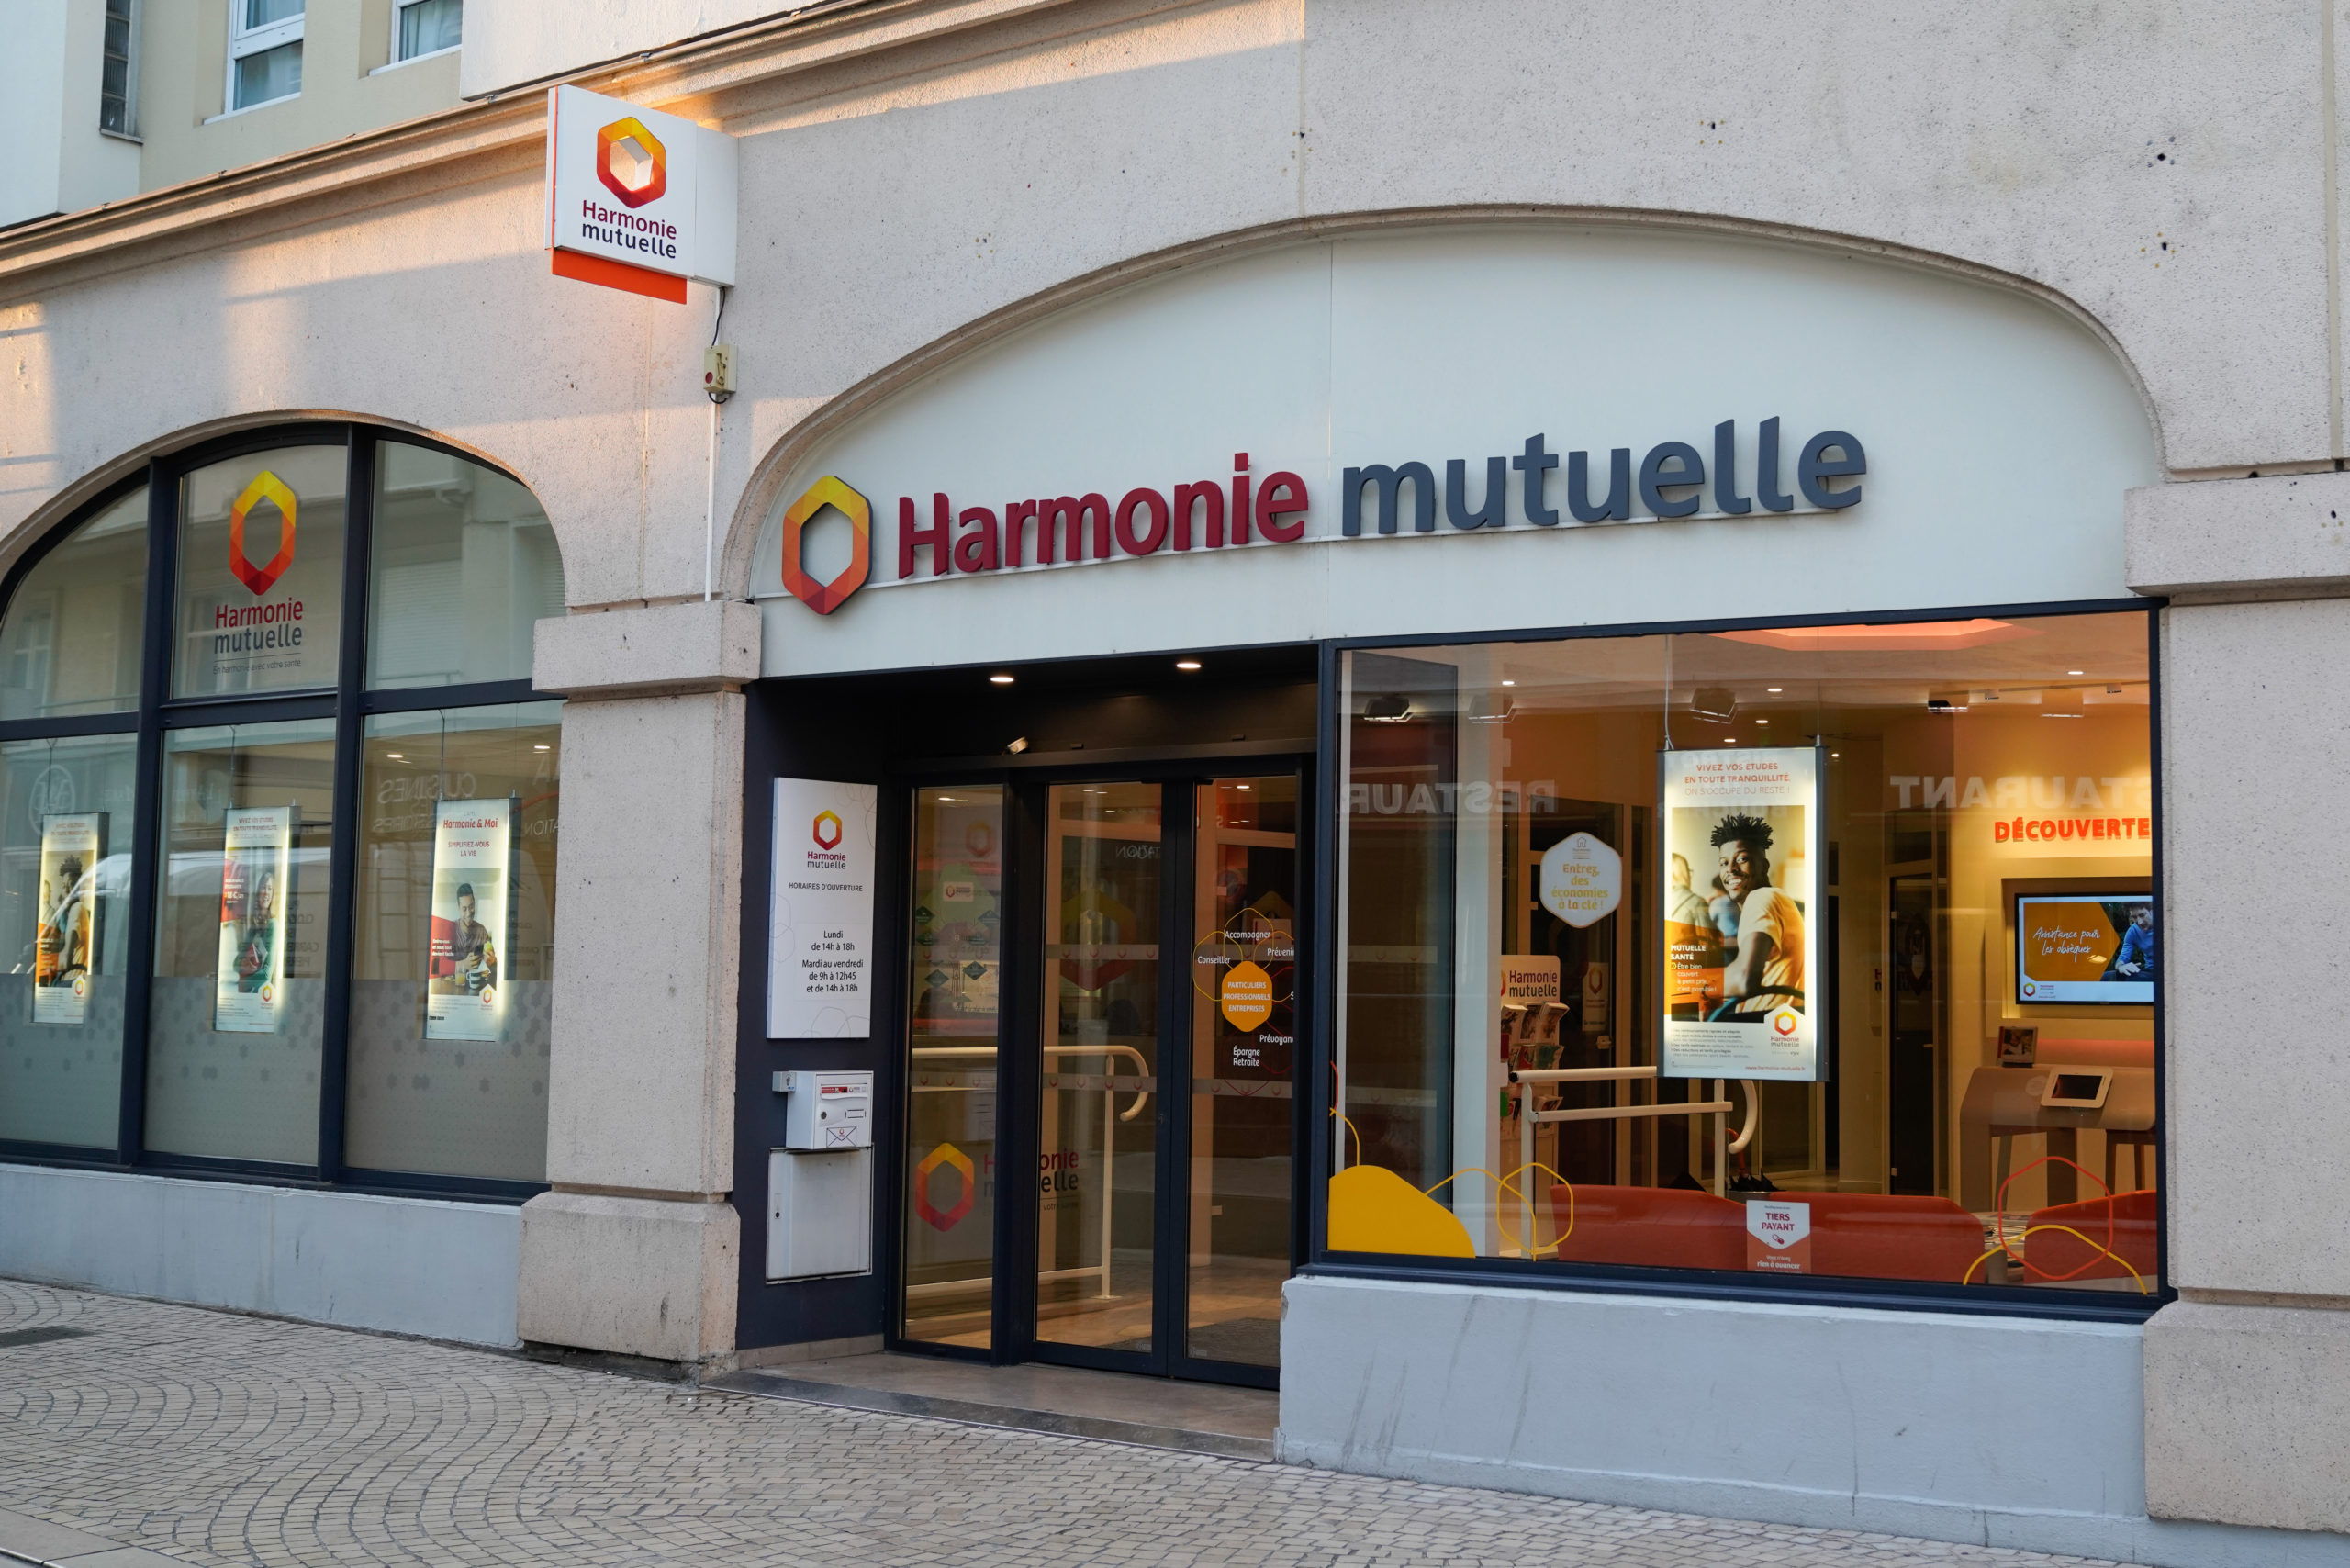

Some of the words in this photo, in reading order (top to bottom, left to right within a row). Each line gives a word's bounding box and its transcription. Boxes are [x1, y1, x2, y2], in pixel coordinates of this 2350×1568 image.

[582, 199, 677, 240] Harmonie
[582, 223, 677, 259] mutuelle
[898, 453, 1309, 580] Harmonie
[1343, 416, 1867, 536] mutuelle
[216, 597, 303, 629] Harmonie
[214, 623, 302, 654] mutuelle
[267, 660, 284, 669] votre
[285, 659, 302, 668] santé
[1696, 764, 1723, 772] VIVEZ
[1684, 776, 1696, 784] EN
[443, 819, 476, 828] Harmonie
[477, 818, 482, 828] &
[485, 817, 498, 828] Moi
[1994, 816, 2151, 842] DÉCOUVERTE
[808, 851, 846, 861] Harmonie
[808, 860, 846, 869] mutuelle
[1571, 875, 1590, 886] des
[789, 882, 820, 890] HORAIRES
[1551, 885, 1608, 898] économies
[1558, 898, 1565, 909] à
[1568, 899, 1579, 909] la
[1581, 899, 1597, 910] clé
[823, 930, 844, 938] Lundi
[1225, 931, 1271, 941] Accompagner
[2033, 925, 2077, 942] Assistance
[2079, 929, 2100, 944] pour
[811, 943, 821, 951] de
[822, 943, 835, 951] 14h
[836, 943, 841, 951] à
[843, 943, 855, 951] 18h
[2056, 940, 2092, 963] obsèques
[1197, 956, 1231, 964] Conseiller
[1671, 952, 1694, 960] SANTÉ
[801, 959, 822, 968] Mardi
[834, 959, 864, 968] vendredi
[809, 972, 818, 980] de
[819, 972, 828, 980] 9h
[836, 972, 856, 980] 12h45
[1509, 970, 1558, 984] Harmonie
[815, 984, 824, 992] de
[826, 984, 838, 992] 14h
[846, 984, 858, 992] 18h
[1509, 984, 1558, 997] mutuelle
[1228, 1004, 1265, 1013] ENTREPRISES
[1233, 1045, 1260, 1058] Épargne
[1233, 1058, 1260, 1067] Retraite
[1765, 1212, 1790, 1221] TIERS
[1762, 1222, 1795, 1231] PAYANT
